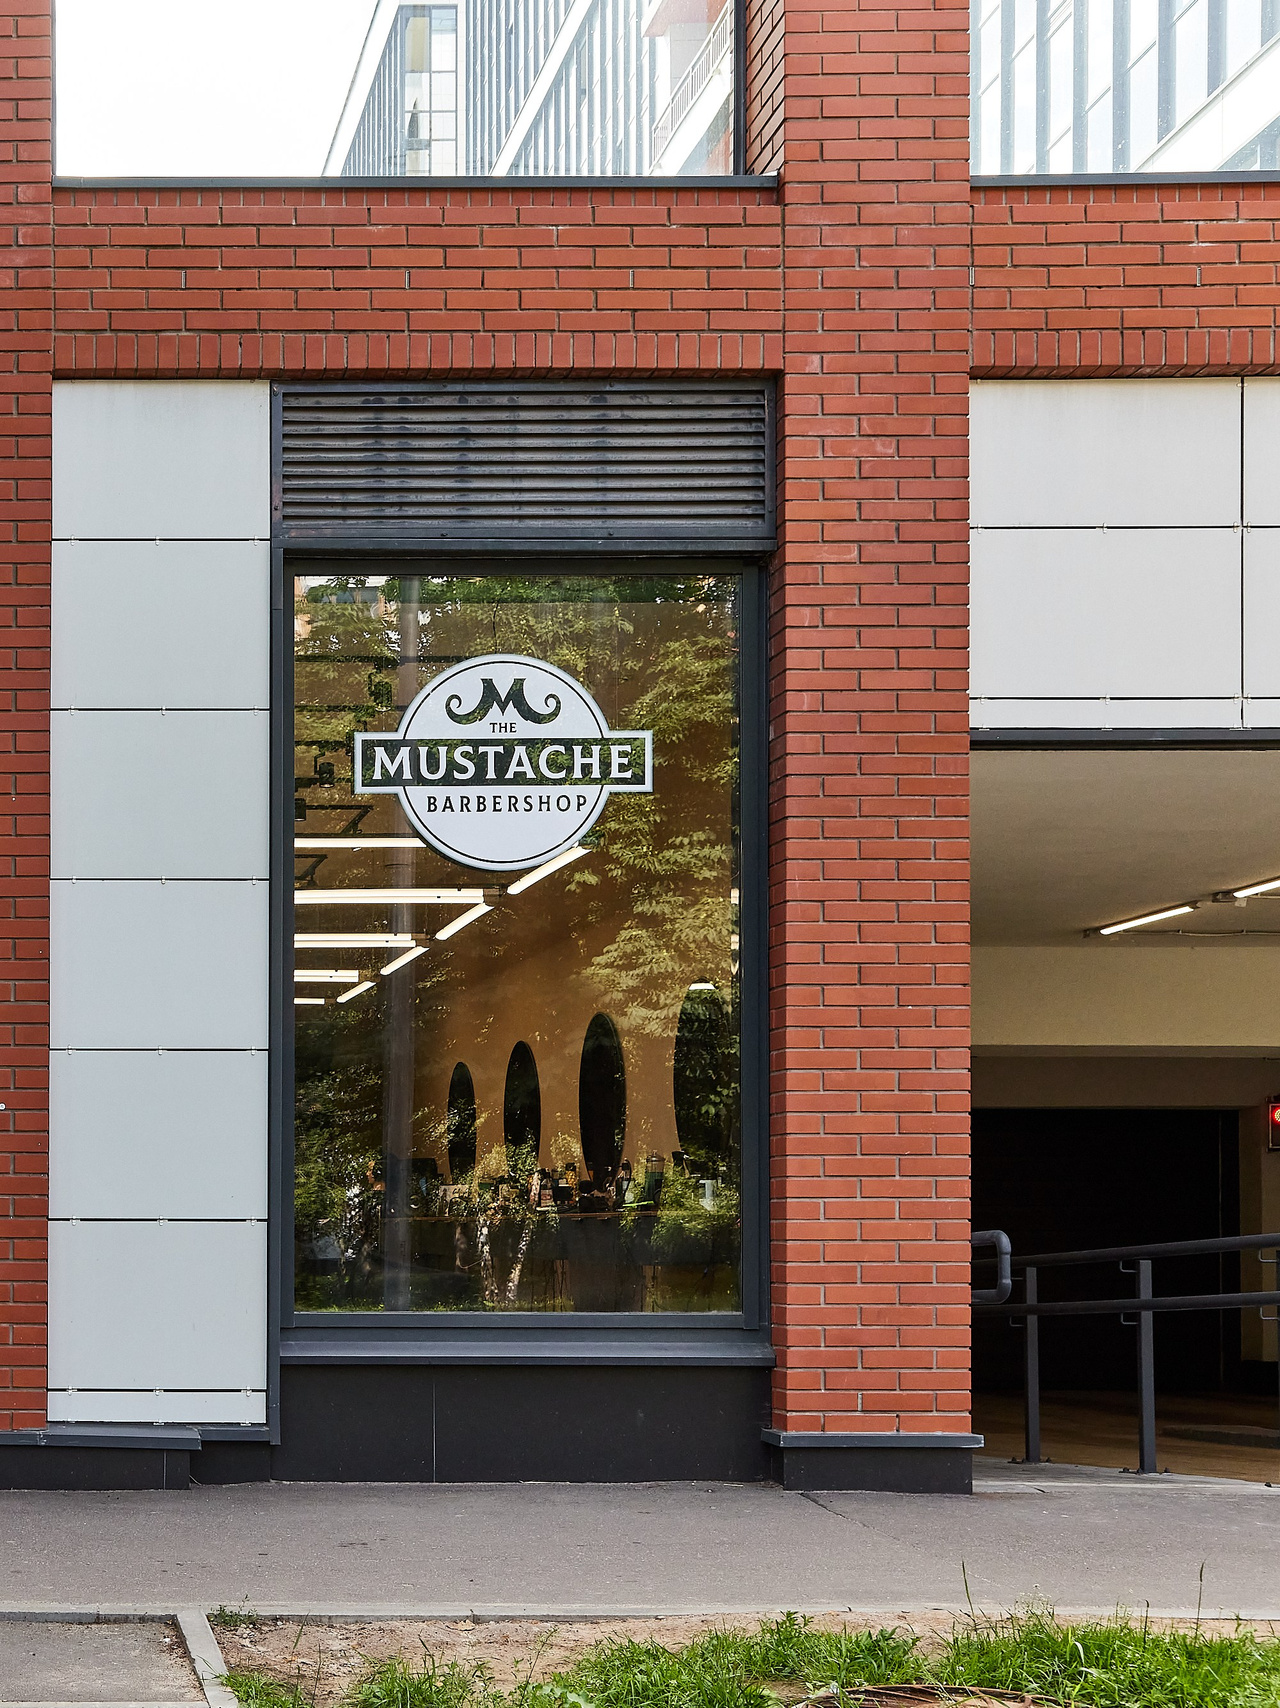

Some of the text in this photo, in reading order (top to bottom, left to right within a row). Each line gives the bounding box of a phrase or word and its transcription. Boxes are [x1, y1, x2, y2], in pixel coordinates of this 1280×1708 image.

[489, 722, 517, 733] THE
[372, 744, 633, 780] MUSTACHE
[426, 794, 587, 813] BARBERSHOP
